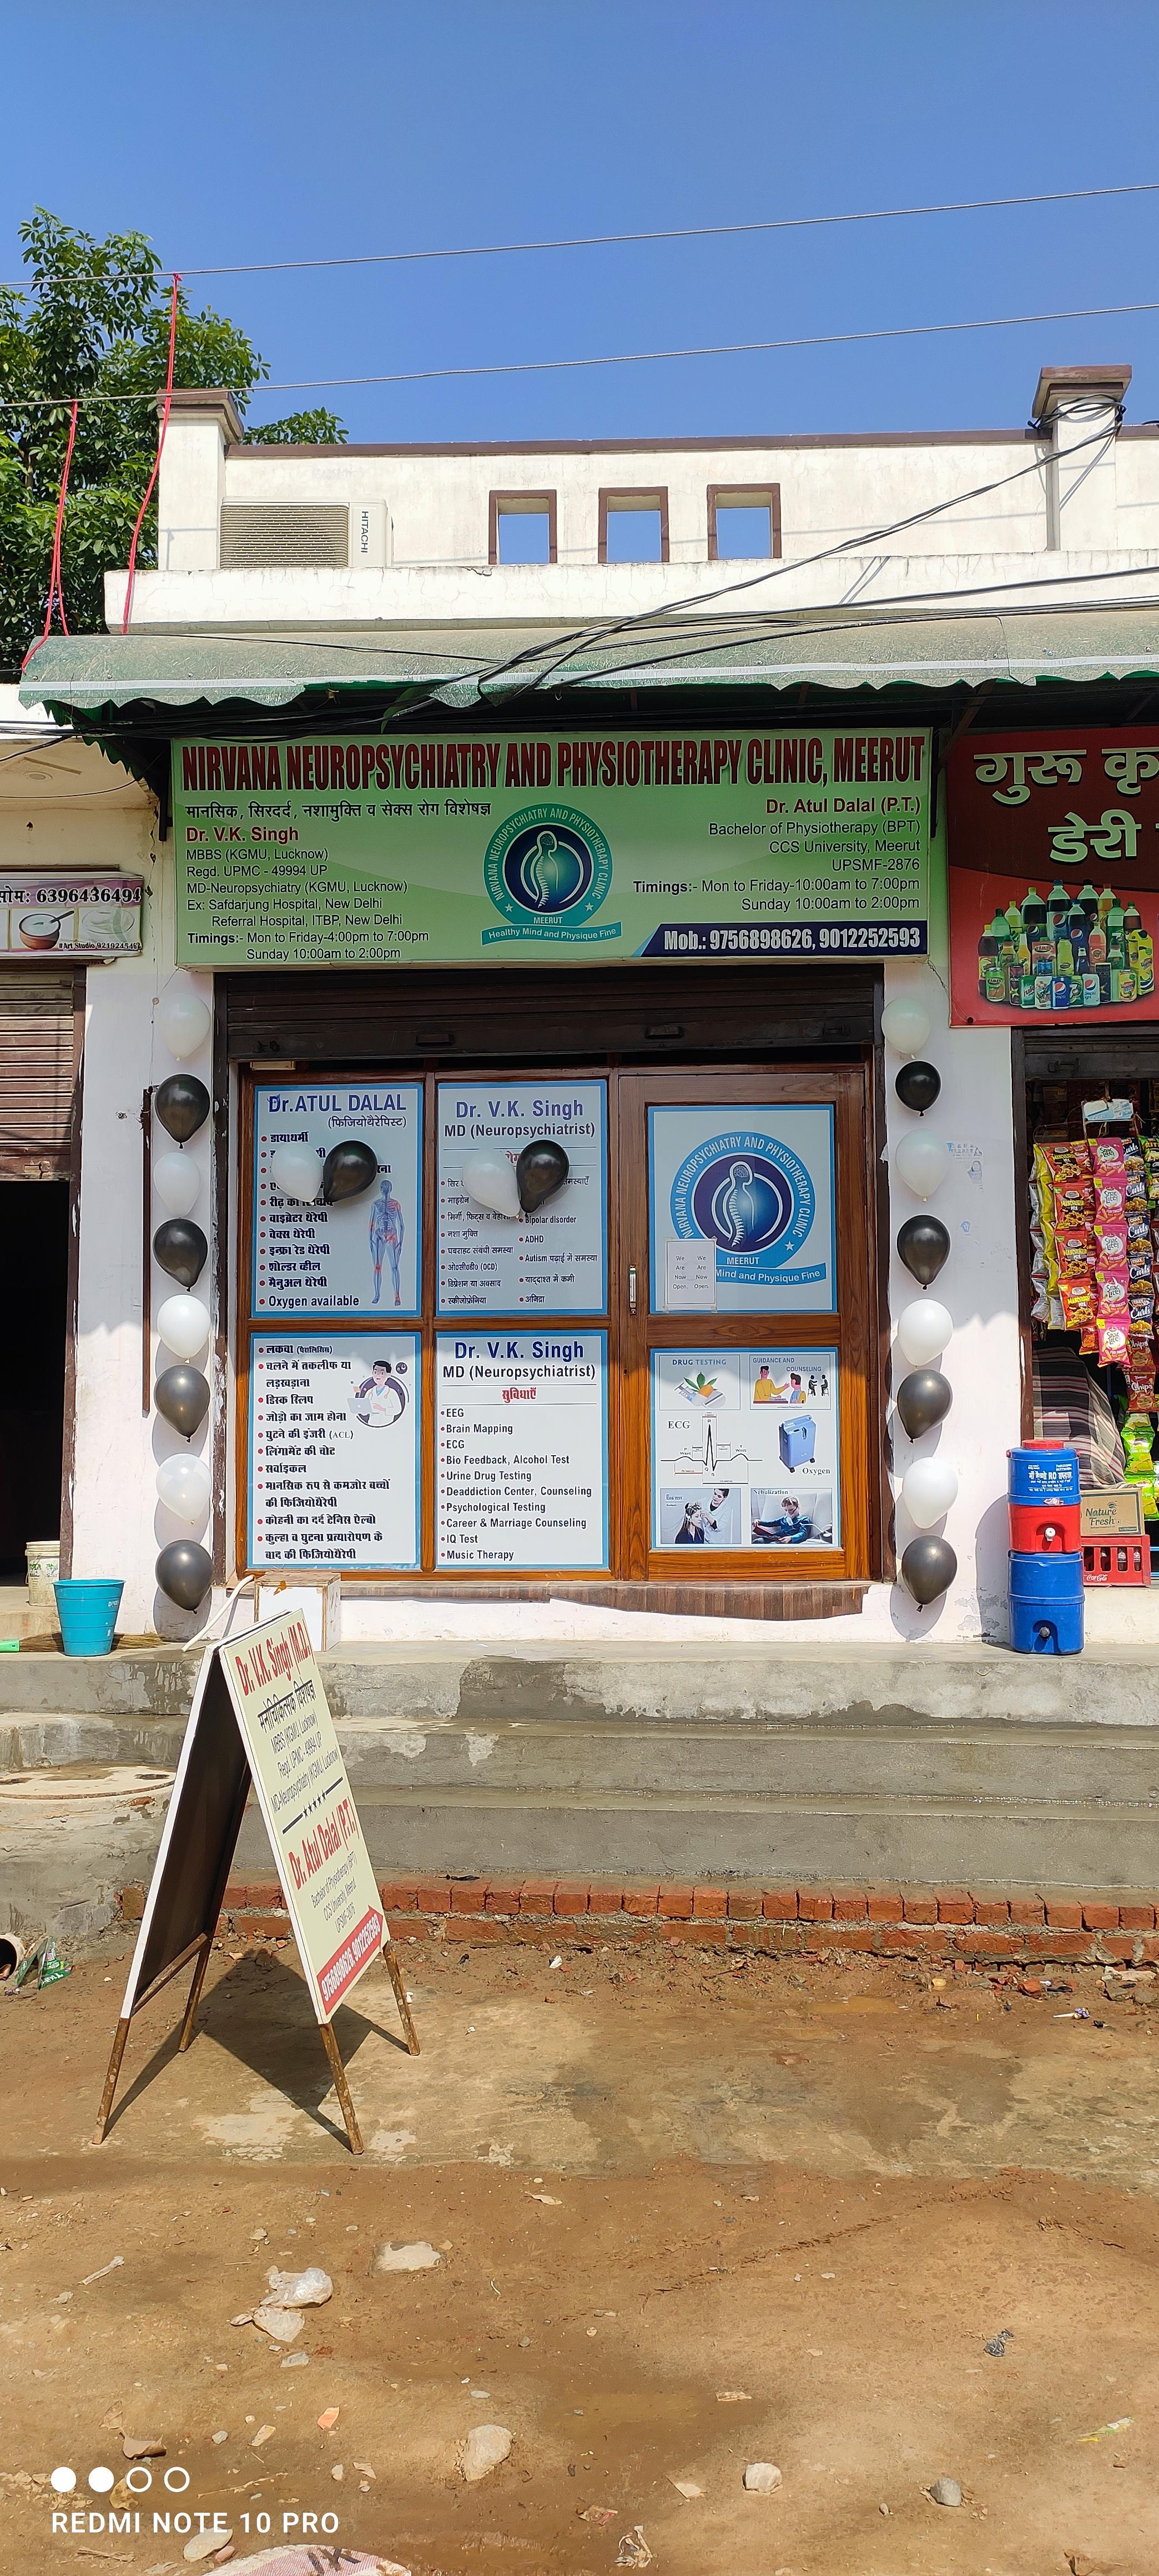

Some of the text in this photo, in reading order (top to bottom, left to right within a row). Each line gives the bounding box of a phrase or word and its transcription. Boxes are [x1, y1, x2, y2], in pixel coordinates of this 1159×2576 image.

[183, 736, 925, 791] NIRVANA NEUROPSYCHIATRY AND PHYSIOTHERAPY CLINIC, MEERUT
[302, 801, 361, 821] नशामुक्ति
[367, 804, 376, 817] व
[381, 800, 412, 817] सेक्स
[419, 799, 439, 816] रोग
[445, 799, 491, 816] विशेषज्ञ
[767, 796, 920, 815] Dr. Atul Dalal (P.T.)
[187, 827, 299, 844] Dr. V.K. Singh
[709, 820, 920, 837] Bachelor of Physiotherapy (BPT)
[1048, 809, 1141, 863] डेरी
[187, 848, 328, 863] MBBS (KGMU, Lucknow)
[769, 840, 920, 856] CCS University, Meerut
[187, 864, 327, 879] Regd. UPMC 49994 UP
[832, 858, 919, 871] UPSMF-2876
[187, 881, 407, 896] MD-Neuropsychiatry (KGMU, Lucknow)
[633, 877, 919, 895] Timings:- Mon to Friday-10:00am to 7:00pm
[37, 888, 141, 902] 6396436494
[188, 898, 382, 914] Ex: Safdarjung Hospital, New Delhi
[742, 897, 919, 913] Sunday 10:00am to 2:00pm
[188, 930, 428, 946] Timings:- Mon to Friday-4:00pm to 7:00pm
[489, 928, 520, 938] Healthy
[523, 928, 542, 936] Mind
[599, 928, 616, 937] Fine
[664, 928, 919, 951] Mob.: 9756898626, 9012252593
[349, 1094, 406, 1110] DALAL
[456, 1100, 583, 1120] Dr. V.K. Singh
[445, 1123, 595, 1139] MD (Neuropsychiatrist)
[758, 1274, 799, 1284] Physique
[801, 1270, 820, 1280] Fine
[269, 1295, 359, 1308] Oxygen available
[455, 1341, 583, 1362] Dr. V.K. Singh
[444, 1365, 595, 1380] MD (Neuropsychiatrist)
[447, 1424, 513, 1434] Brain Mapping
[668, 1421, 691, 1429] ECG
[447, 1440, 464, 1448] ECG
[447, 1455, 570, 1465] Bio Feedback, Alcohol Test
[447, 1471, 531, 1482] Urine Drug Testing
[447, 1502, 545, 1513] Psychological Testing
[1090, 1516, 1115, 1526] Fresh
[447, 1534, 478, 1543] IQ Test
[447, 1550, 514, 1561] Music Therapy
[235, 1657, 255, 1696] Dr.
[248, 1644, 272, 1687] V.K.
[266, 1632, 293, 1681] Singh
[289, 1852, 306, 1891] Dr.
[302, 1829, 322, 1878] Atul
[317, 1807, 342, 1861] Dalal
